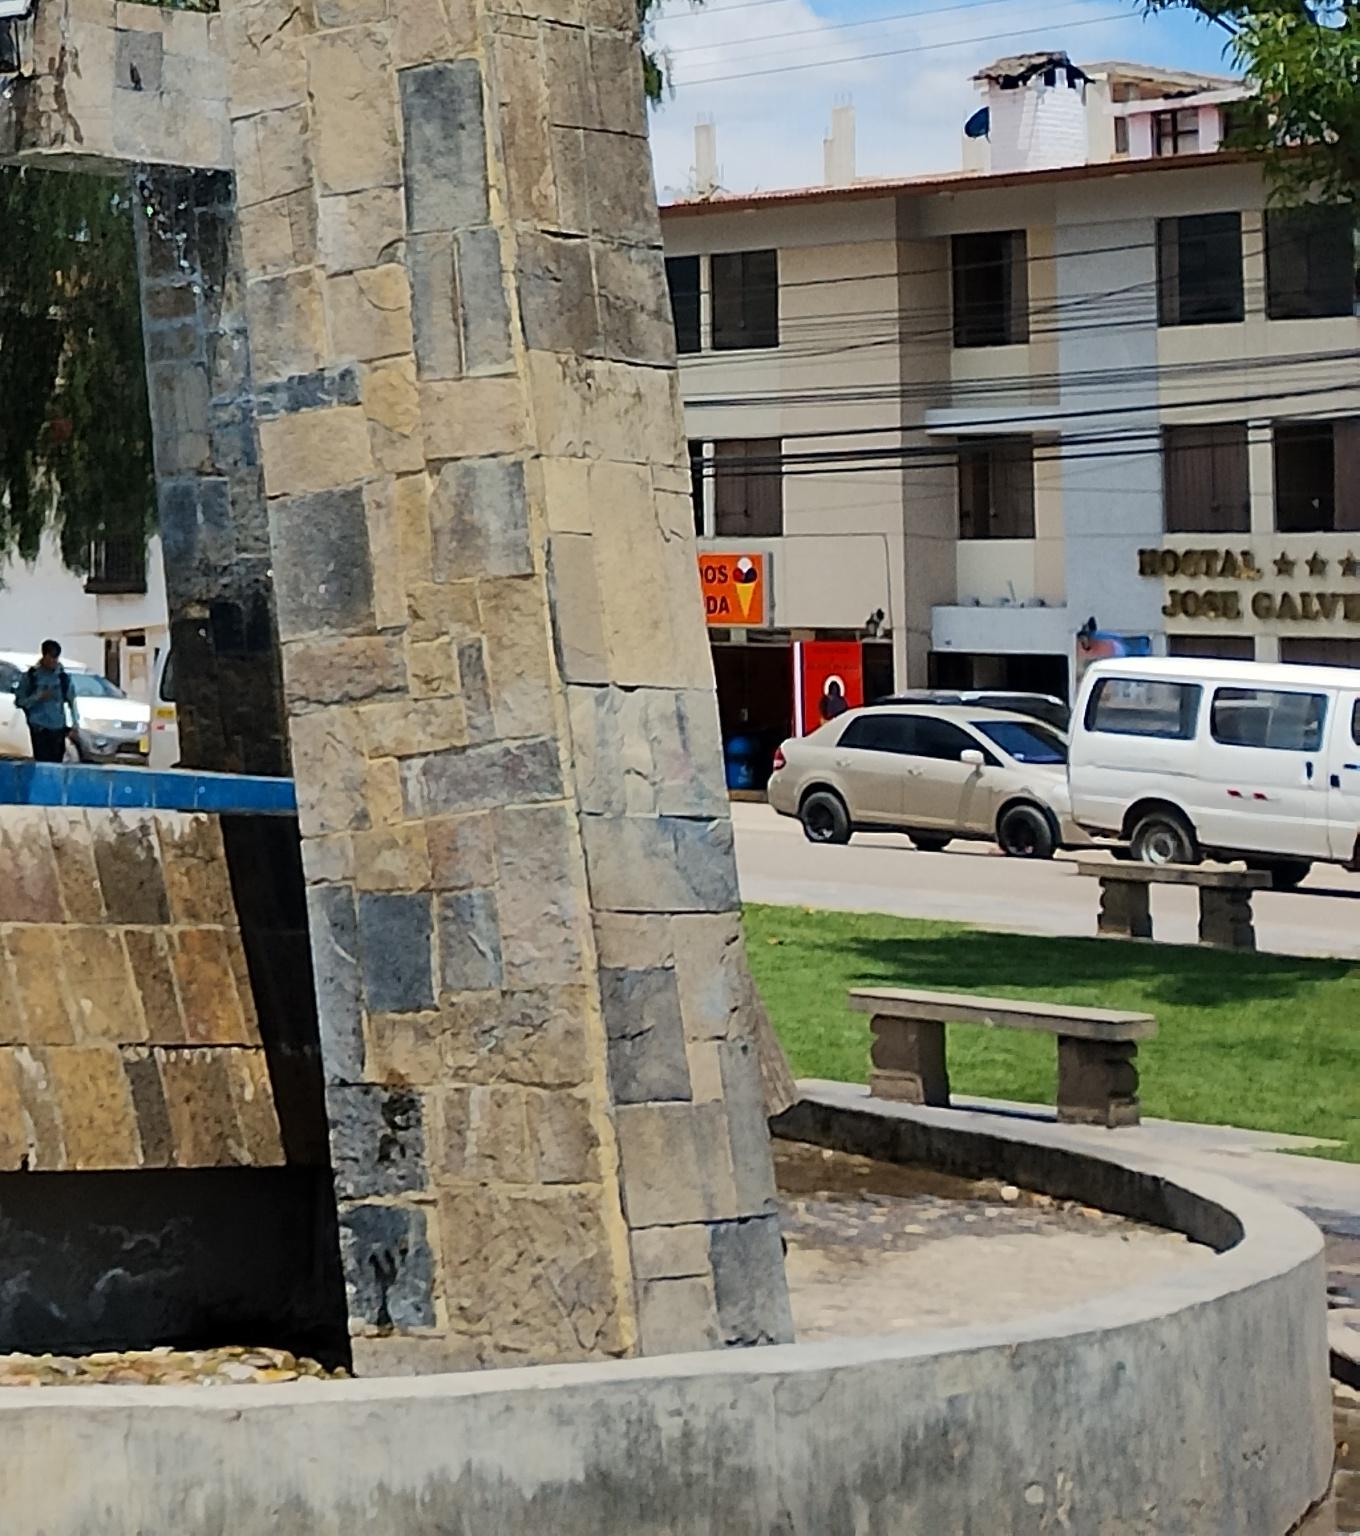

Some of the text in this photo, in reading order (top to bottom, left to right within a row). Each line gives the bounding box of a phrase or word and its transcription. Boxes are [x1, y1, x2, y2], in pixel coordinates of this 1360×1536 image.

[700, 565, 729, 584] OS
[1137, 548, 1263, 579] HOSTAL
[1162, 589, 1243, 619] JOSE
